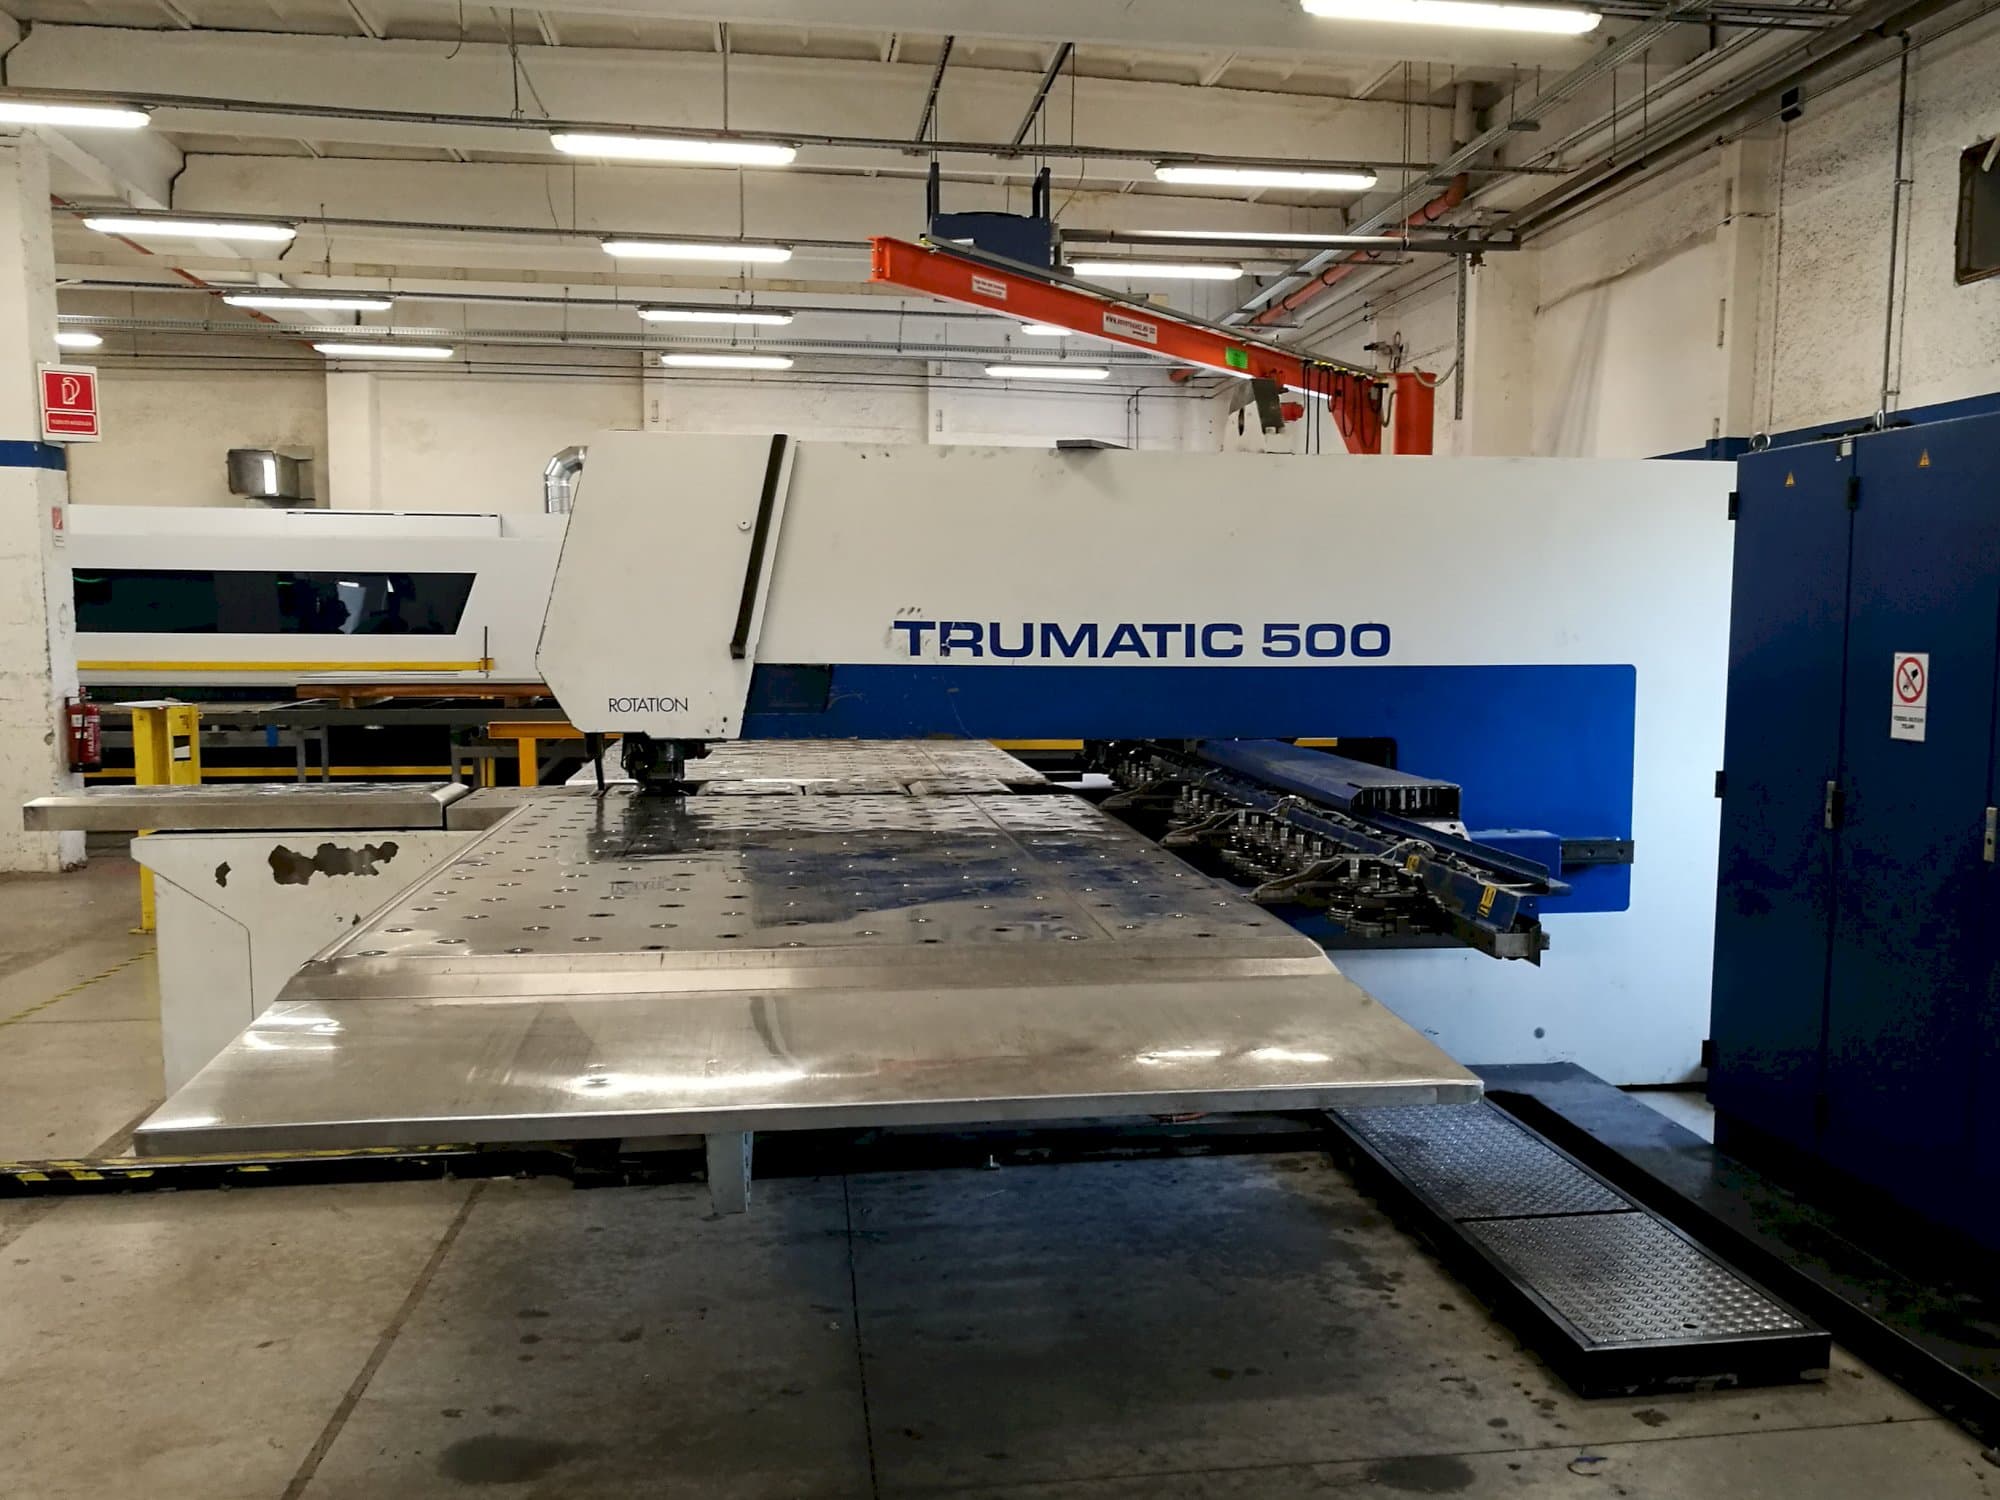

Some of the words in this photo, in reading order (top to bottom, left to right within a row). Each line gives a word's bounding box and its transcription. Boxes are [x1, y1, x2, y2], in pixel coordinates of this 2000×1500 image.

[894, 621, 1243, 658] TRUMATIC
[1262, 623, 1390, 658] 500
[608, 697, 688, 713] ROTATION
